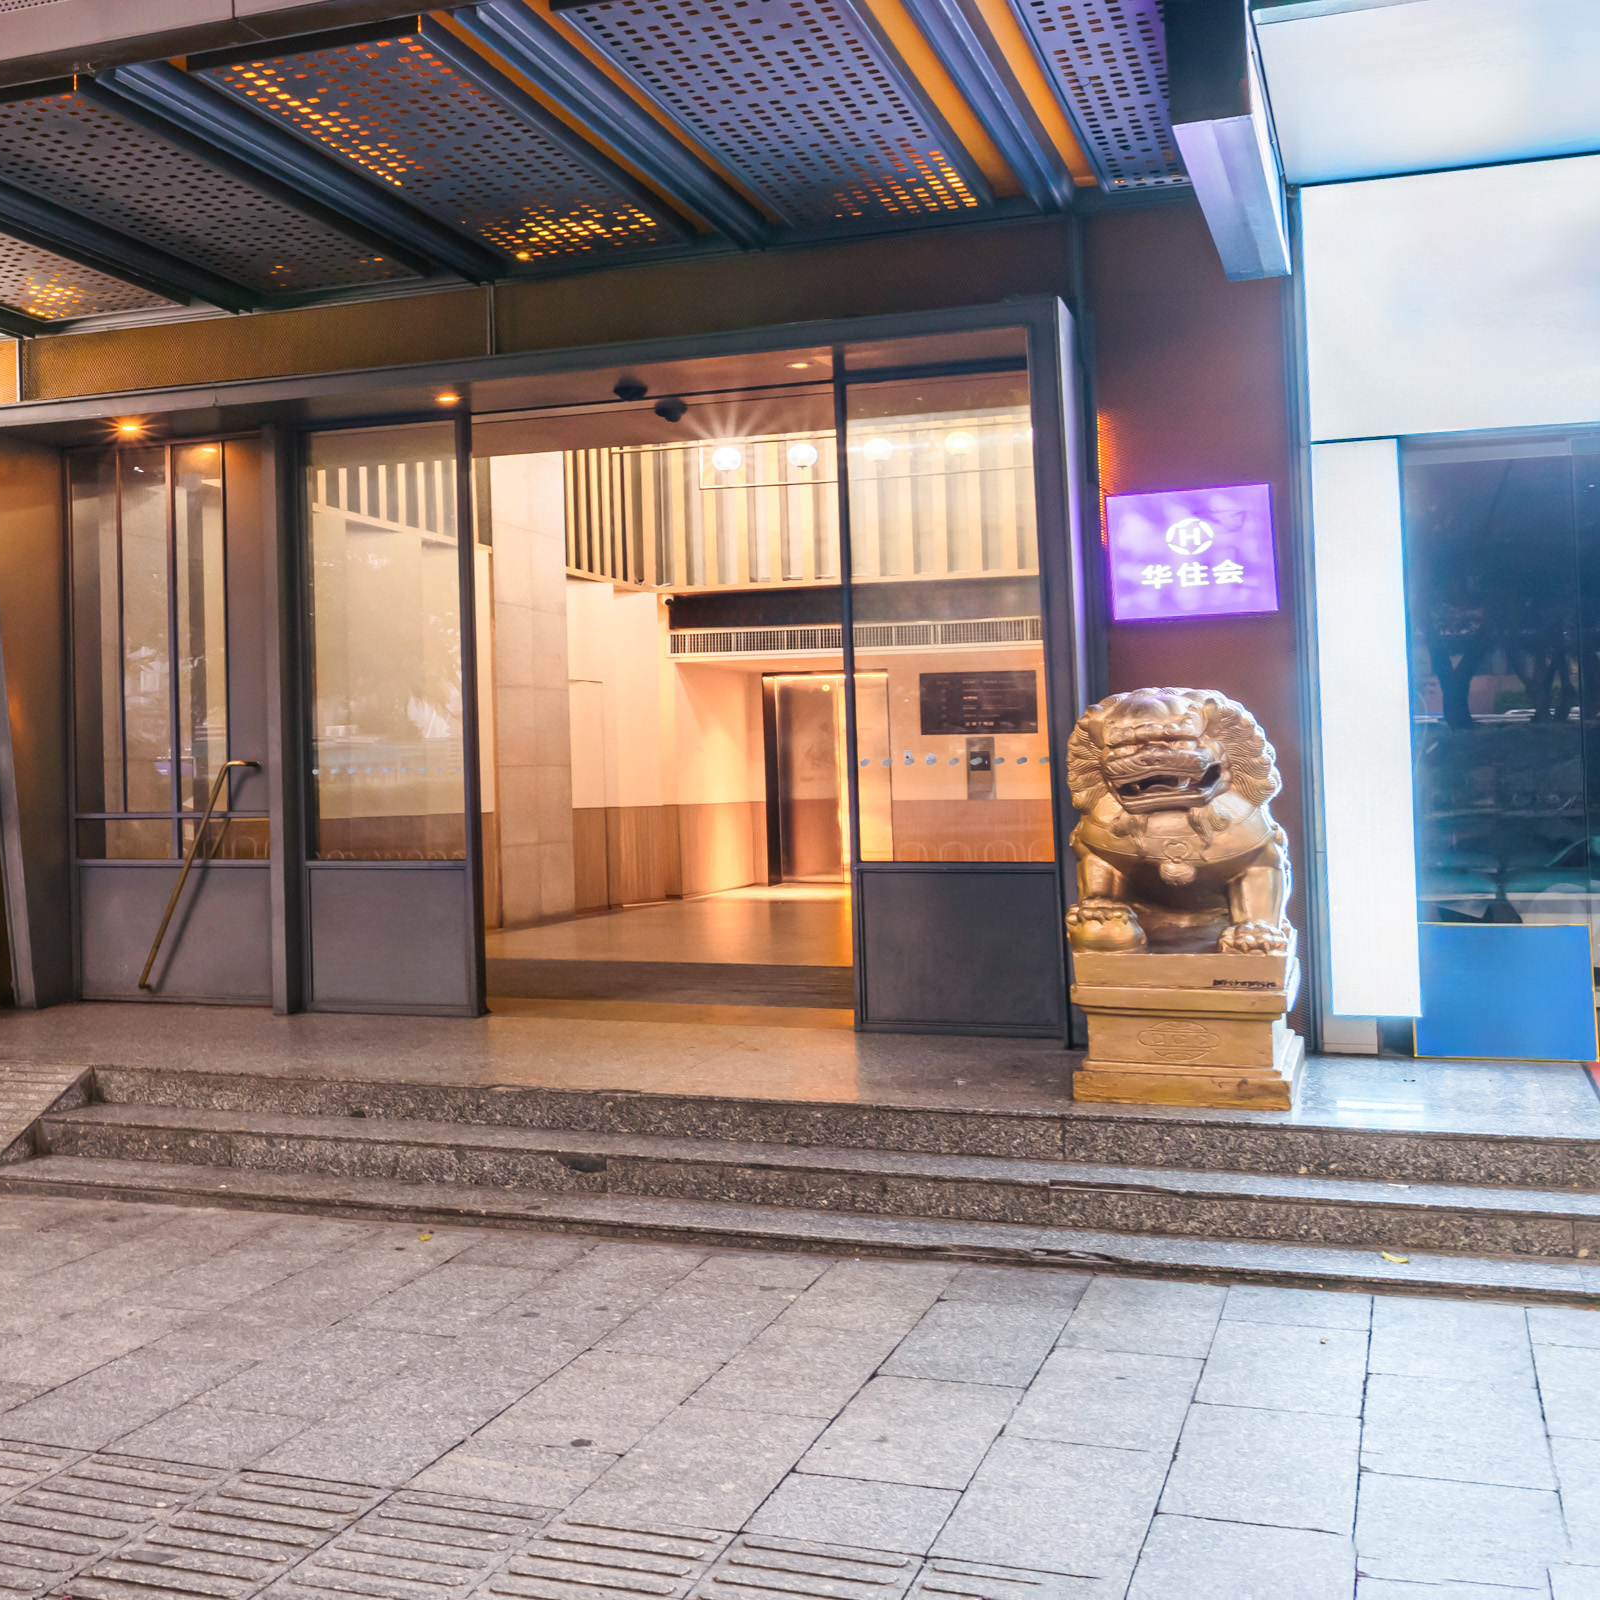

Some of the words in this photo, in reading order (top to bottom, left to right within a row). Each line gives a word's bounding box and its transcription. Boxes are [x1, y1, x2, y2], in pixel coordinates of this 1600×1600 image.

[1178, 527, 1201, 547] H
[1140, 558, 1245, 590] 华住会
